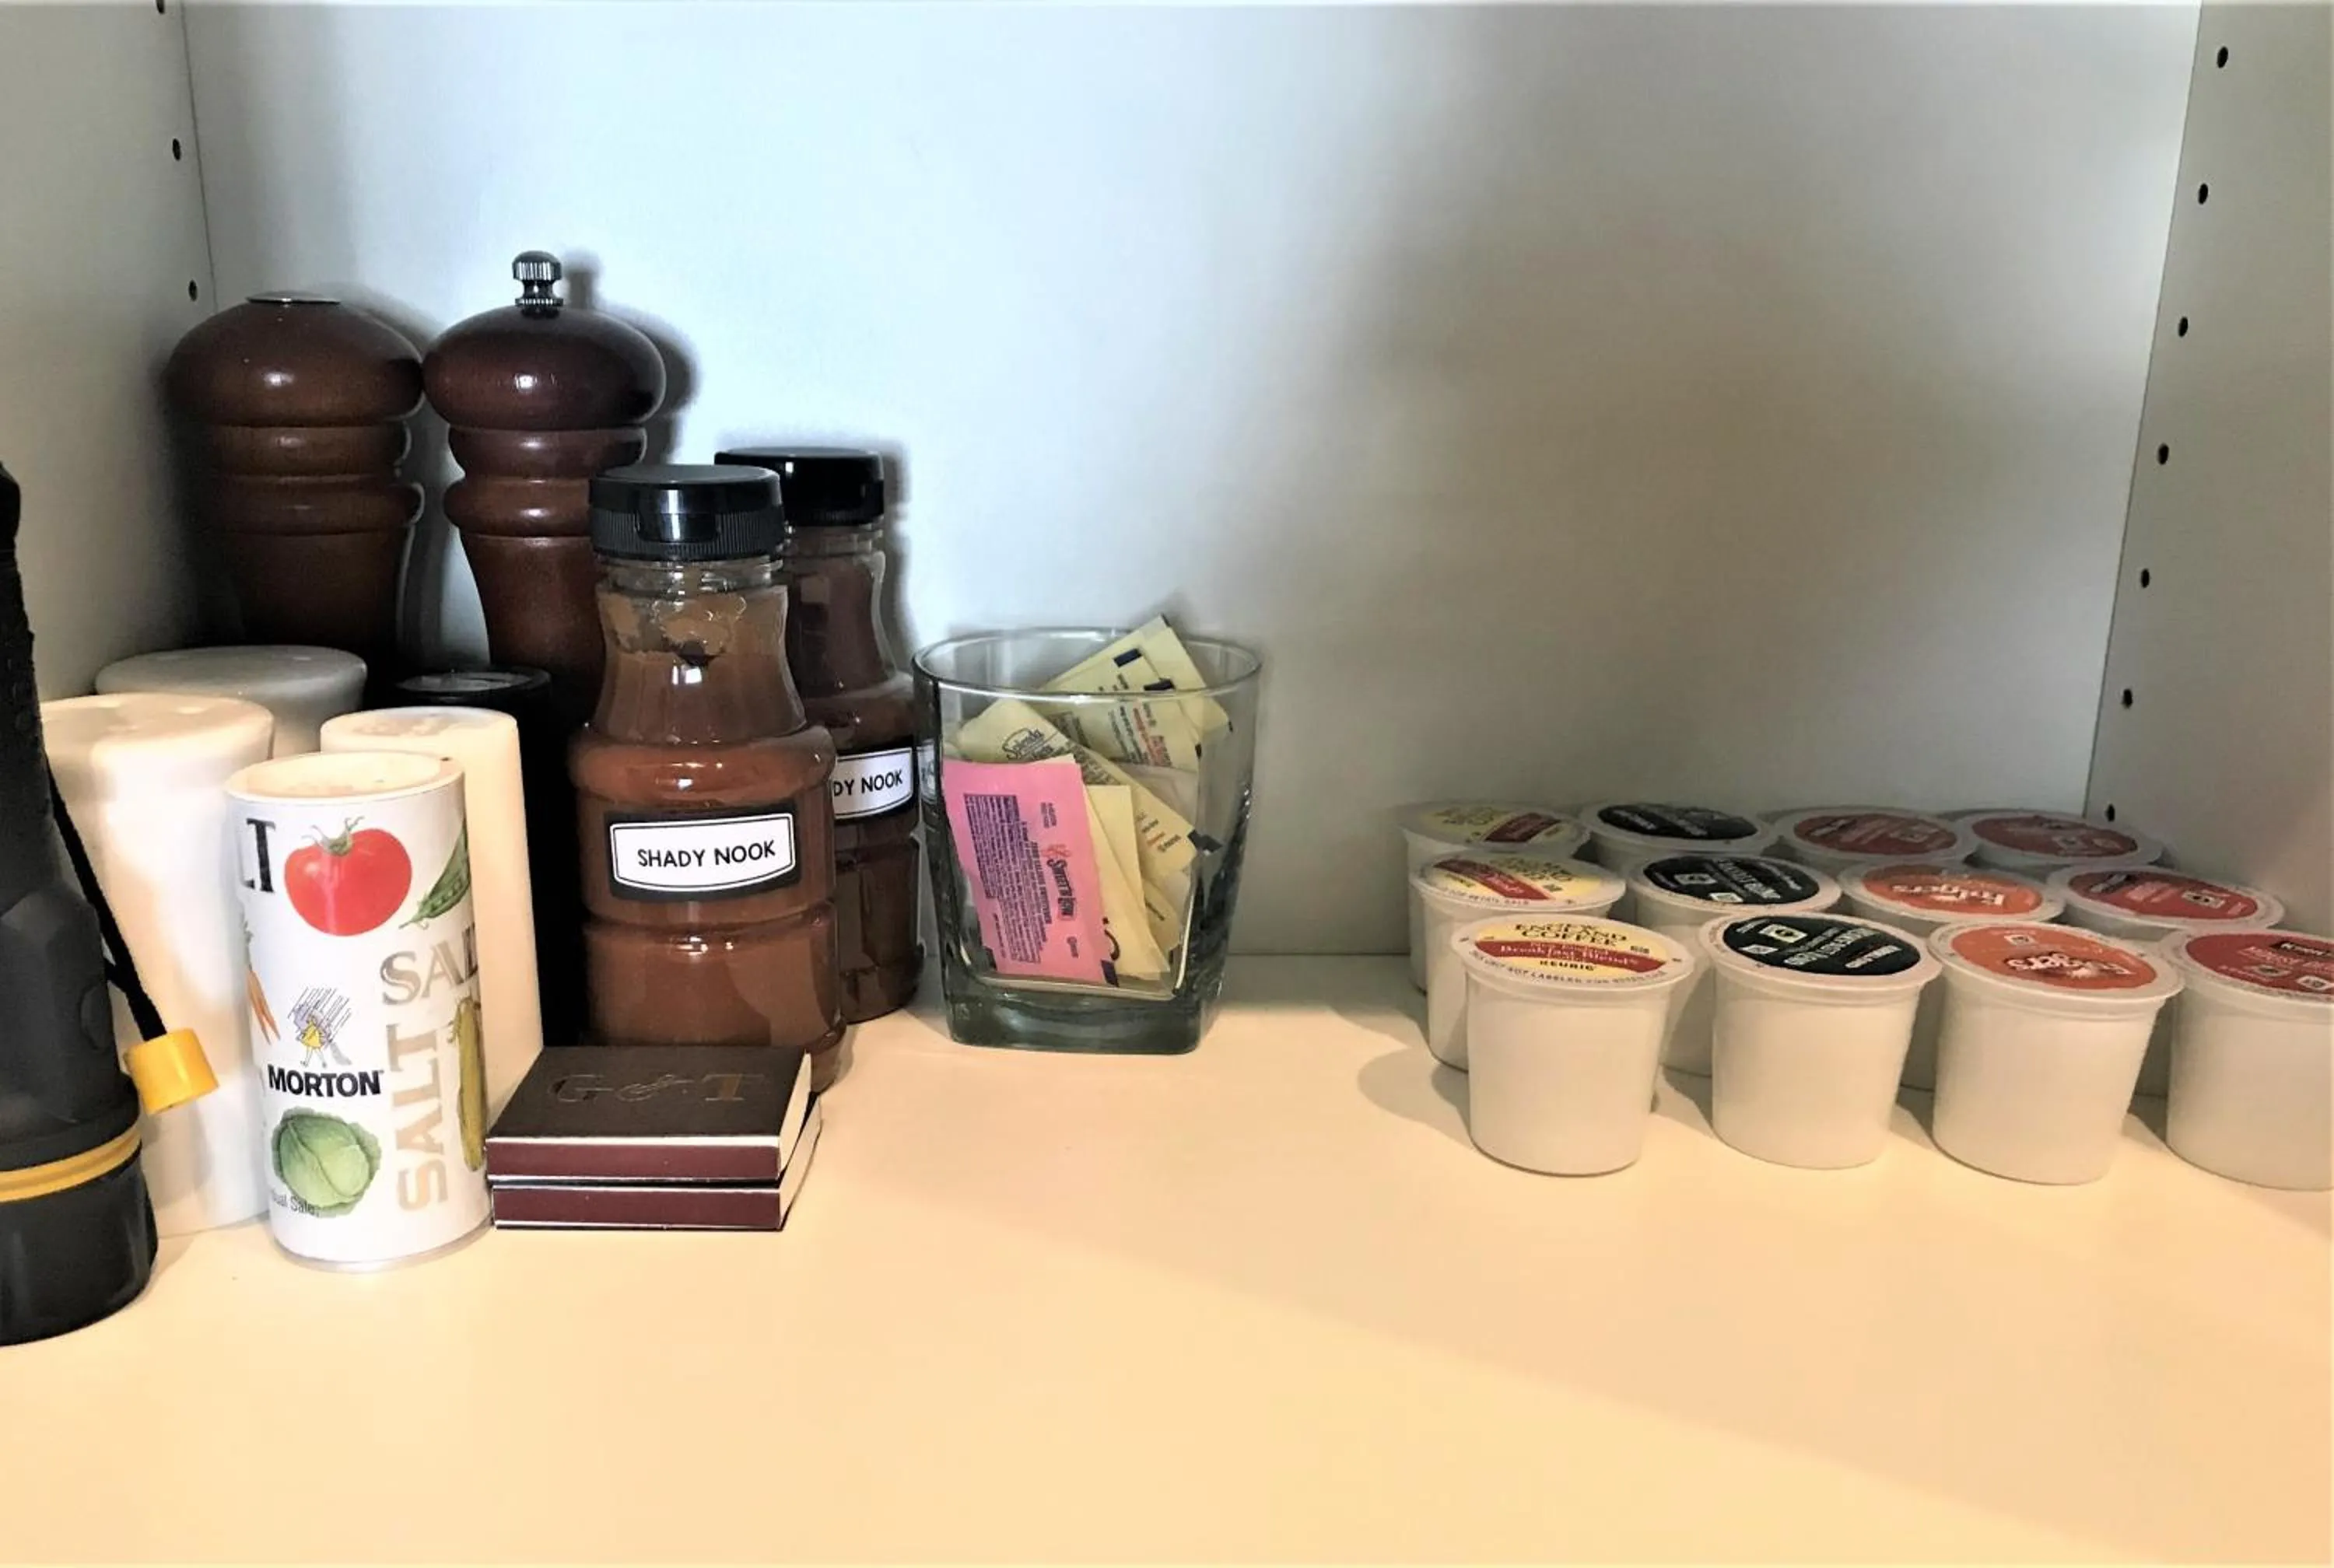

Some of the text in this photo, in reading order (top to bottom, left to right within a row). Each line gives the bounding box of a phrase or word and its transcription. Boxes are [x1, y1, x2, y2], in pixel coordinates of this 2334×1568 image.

[833, 769, 903, 796] DY NOOK
[237, 817, 275, 893] LT
[637, 839, 776, 867] SHADY NOOK
[1521, 931, 1617, 947] COFFEE
[380, 921, 478, 1005] SAL
[1540, 961, 1596, 971] KEURIG
[268, 1063, 381, 1097] MORTON
[386, 1023, 448, 1211] SALT
